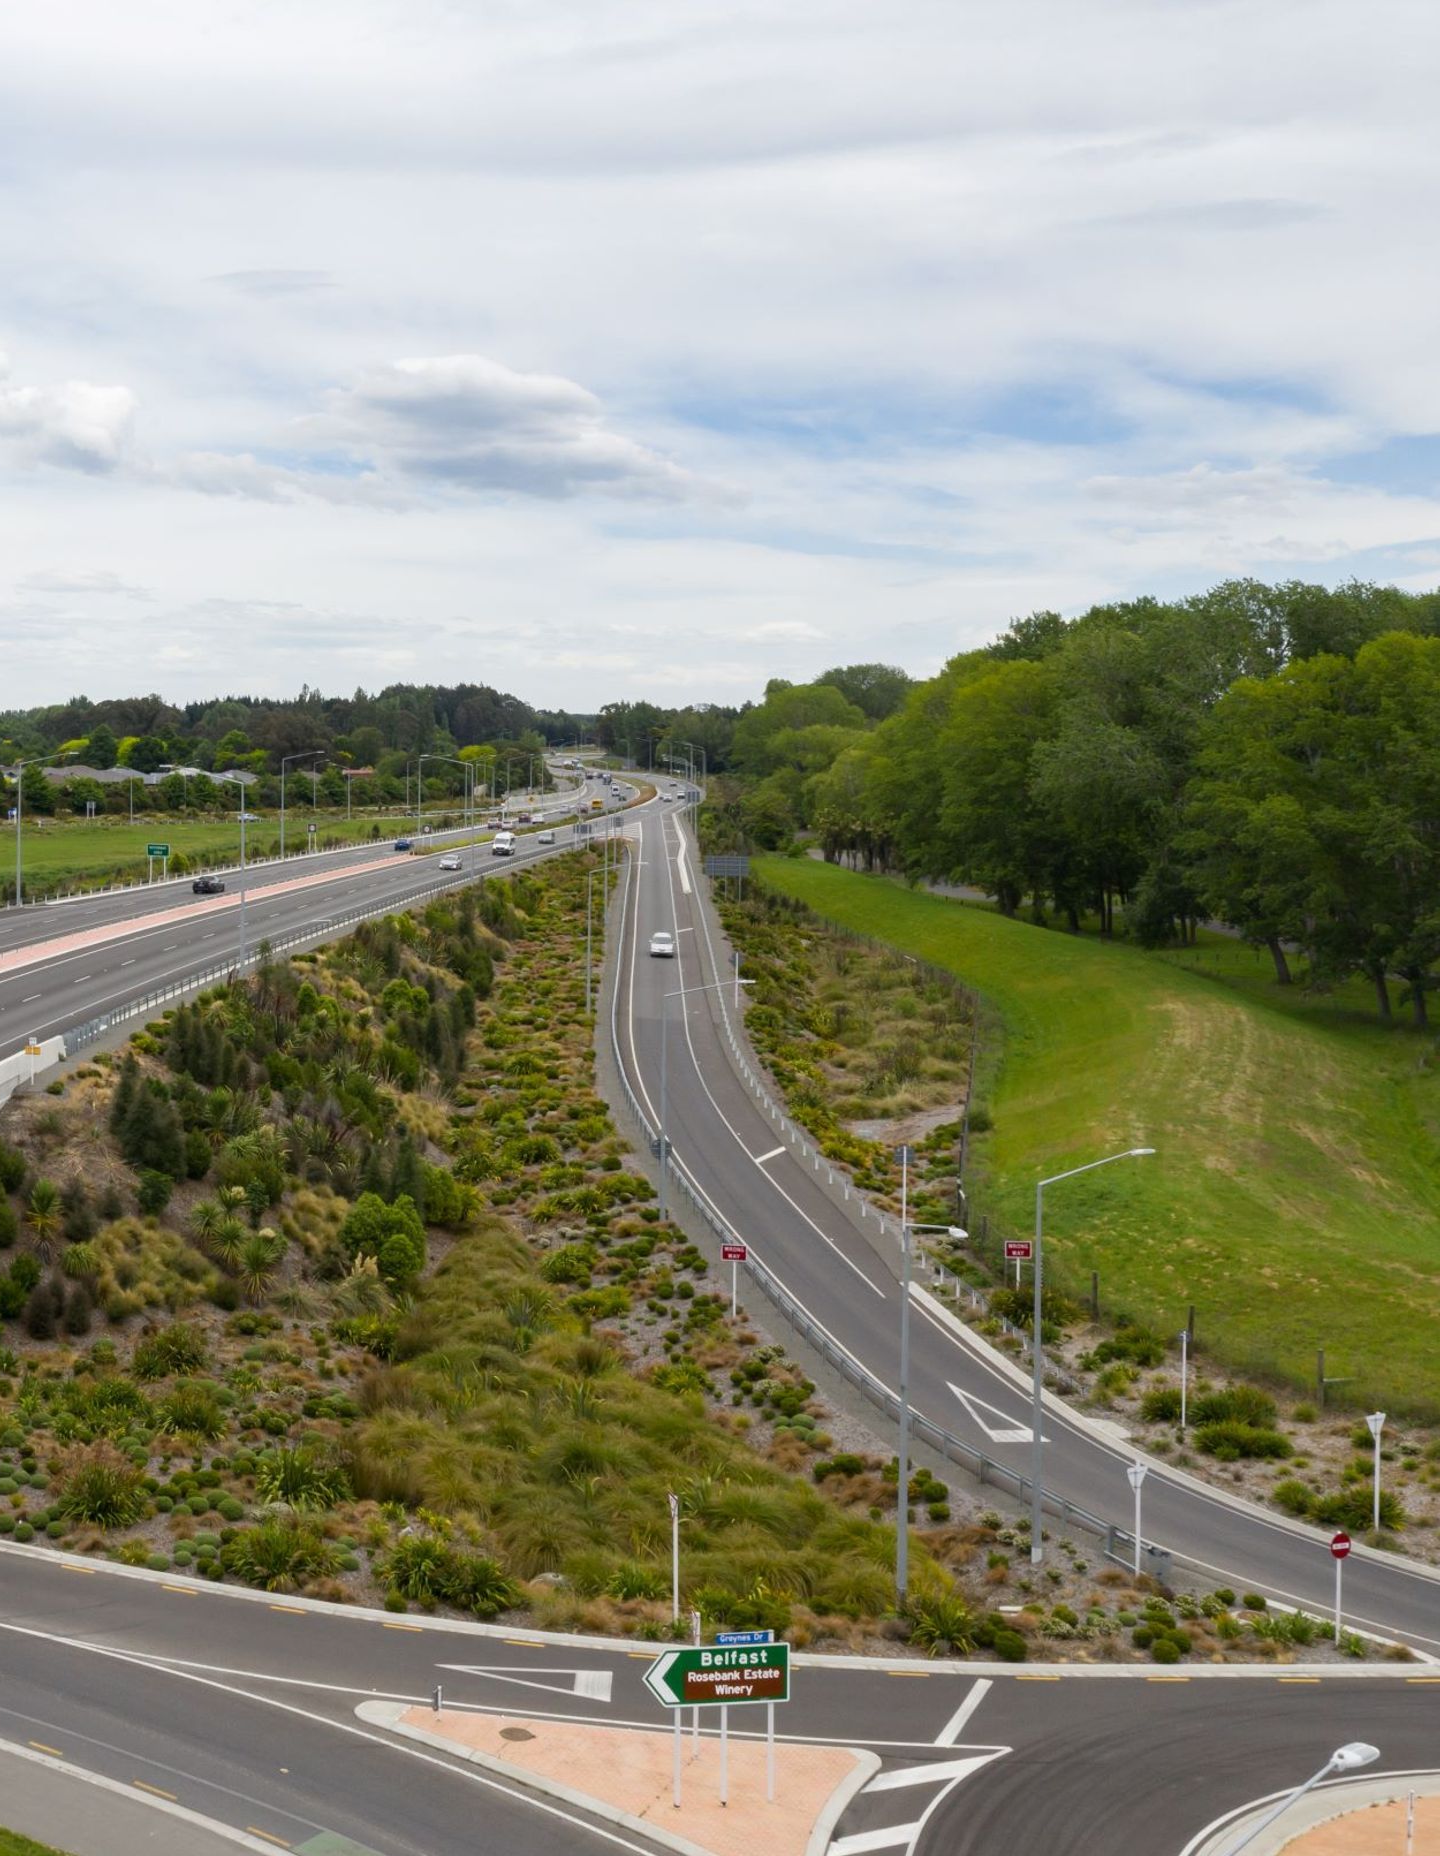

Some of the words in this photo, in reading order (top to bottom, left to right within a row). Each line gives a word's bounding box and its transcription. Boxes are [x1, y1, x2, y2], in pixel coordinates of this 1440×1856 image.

[754, 1633, 763, 1641] Dr
[701, 1649, 768, 1666] Belfast
[687, 1670, 740, 1682] Rosebank
[744, 1668, 780, 1680] Estate
[715, 1684, 753, 1696] Winery
